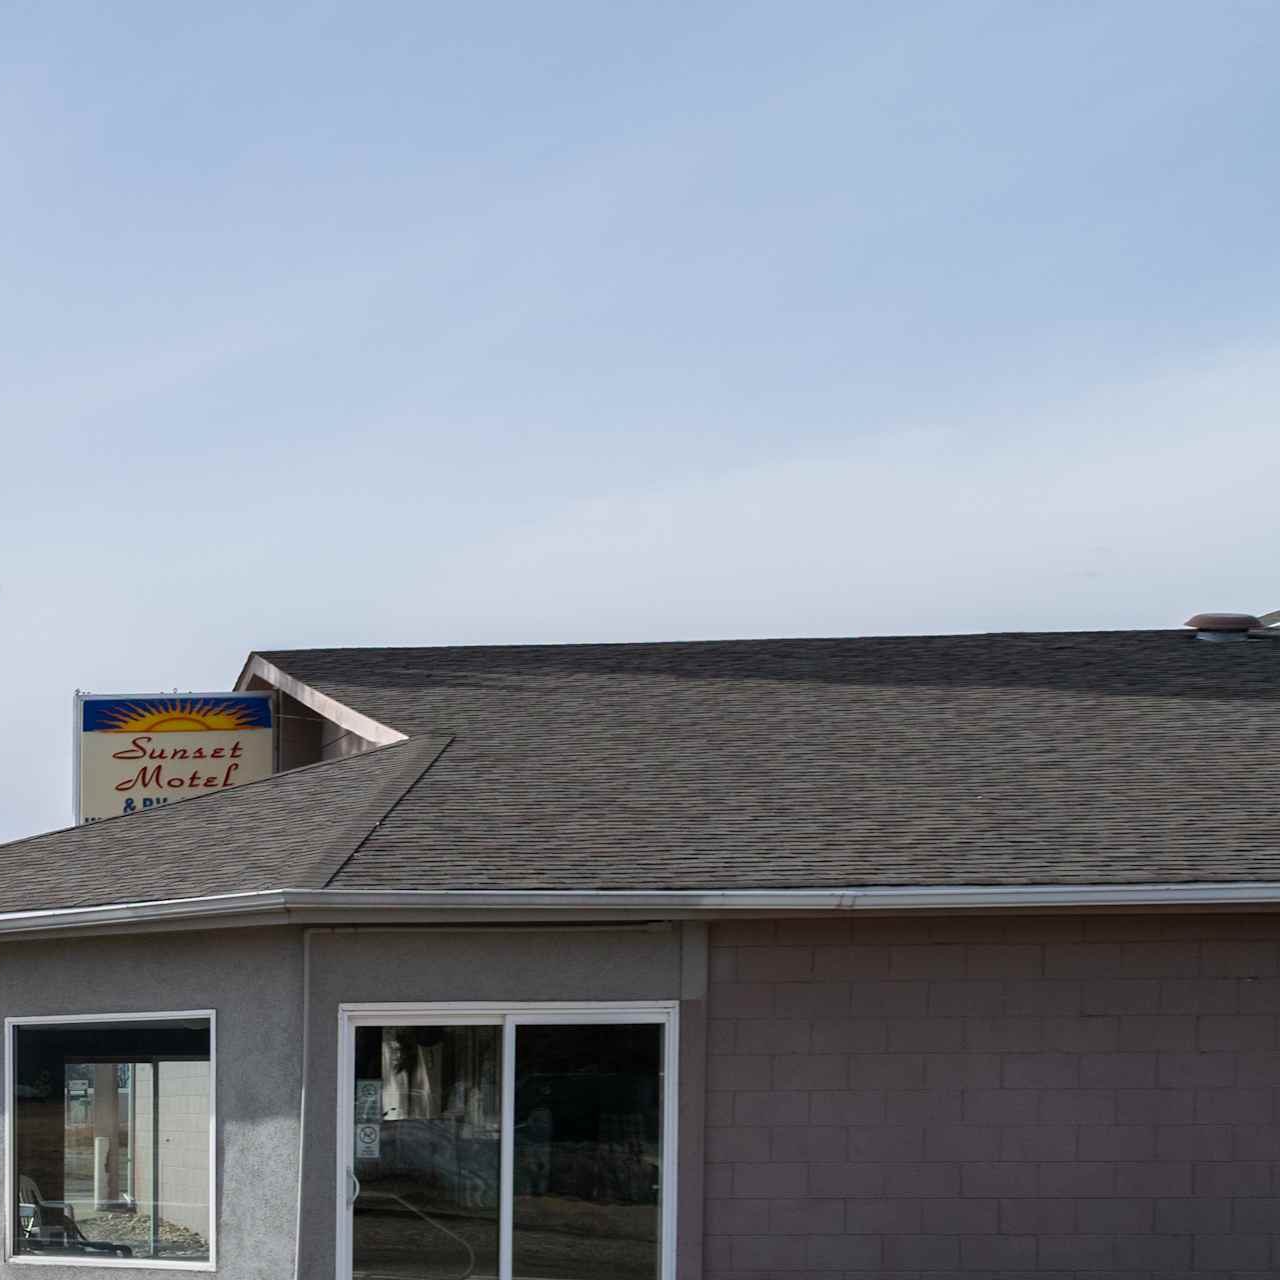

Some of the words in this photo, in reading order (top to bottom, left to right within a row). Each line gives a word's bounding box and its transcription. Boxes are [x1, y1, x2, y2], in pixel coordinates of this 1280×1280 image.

[112, 736, 243, 760] Sunset
[115, 763, 239, 791] Motel
[123, 797, 136, 813] &
